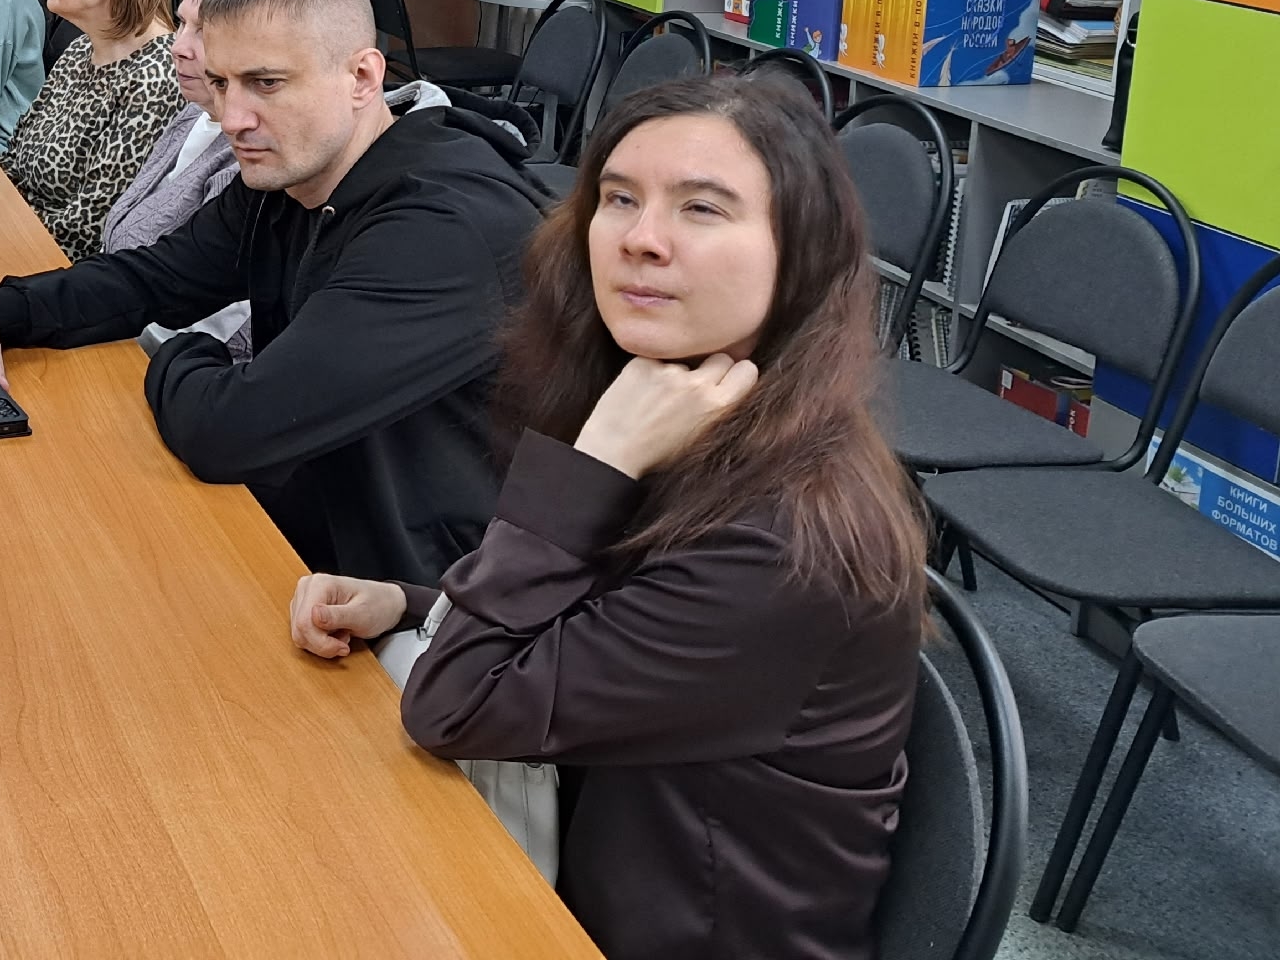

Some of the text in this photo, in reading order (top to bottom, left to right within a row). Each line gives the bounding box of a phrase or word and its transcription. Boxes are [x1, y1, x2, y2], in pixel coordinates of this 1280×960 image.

[790, 0, 798, 45] КНИЖКИ
[910, 33, 919, 78] КНИЖКИ
[1217, 496, 1277, 534] БОЛЬШИХ
[1230, 486, 1268, 513] КНИГИ
[1211, 509, 1278, 551] ФОРМАТОВ
